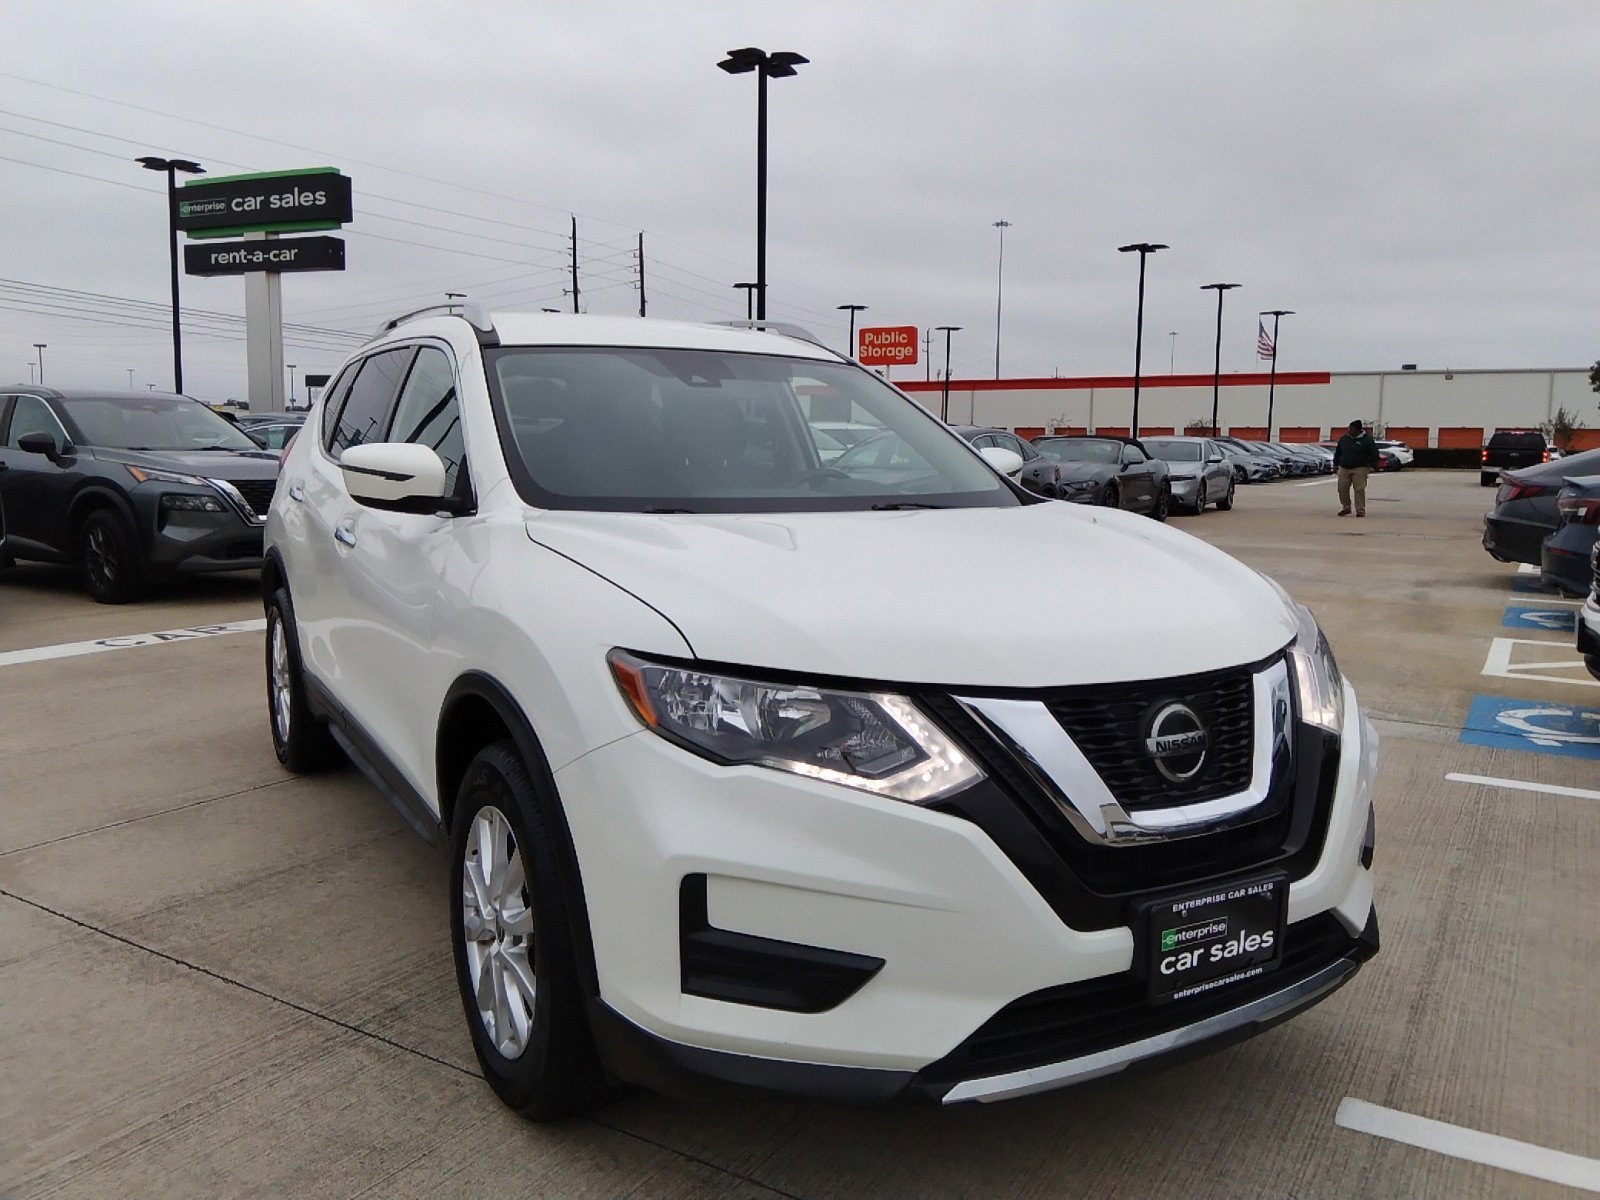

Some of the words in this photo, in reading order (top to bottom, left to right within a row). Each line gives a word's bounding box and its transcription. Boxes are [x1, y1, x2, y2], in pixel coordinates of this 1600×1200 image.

[180, 200, 226, 214] enterprise
[231, 195, 265, 211] car
[269, 187, 327, 209] sales
[211, 247, 298, 265] rent-a-car
[865, 331, 908, 344] Public
[860, 345, 913, 360] Storage
[1155, 735, 1205, 752] NISSAN
[1172, 893, 1226, 913] ENTERPRISE
[1227, 888, 1247, 900] CAR
[1247, 882, 1274, 895] SALES
[1164, 921, 1226, 945] enterprise
[1160, 948, 1204, 975] car
[1209, 929, 1274, 963] sales
[1173, 967, 1263, 1000] enterprisecarsales.com
